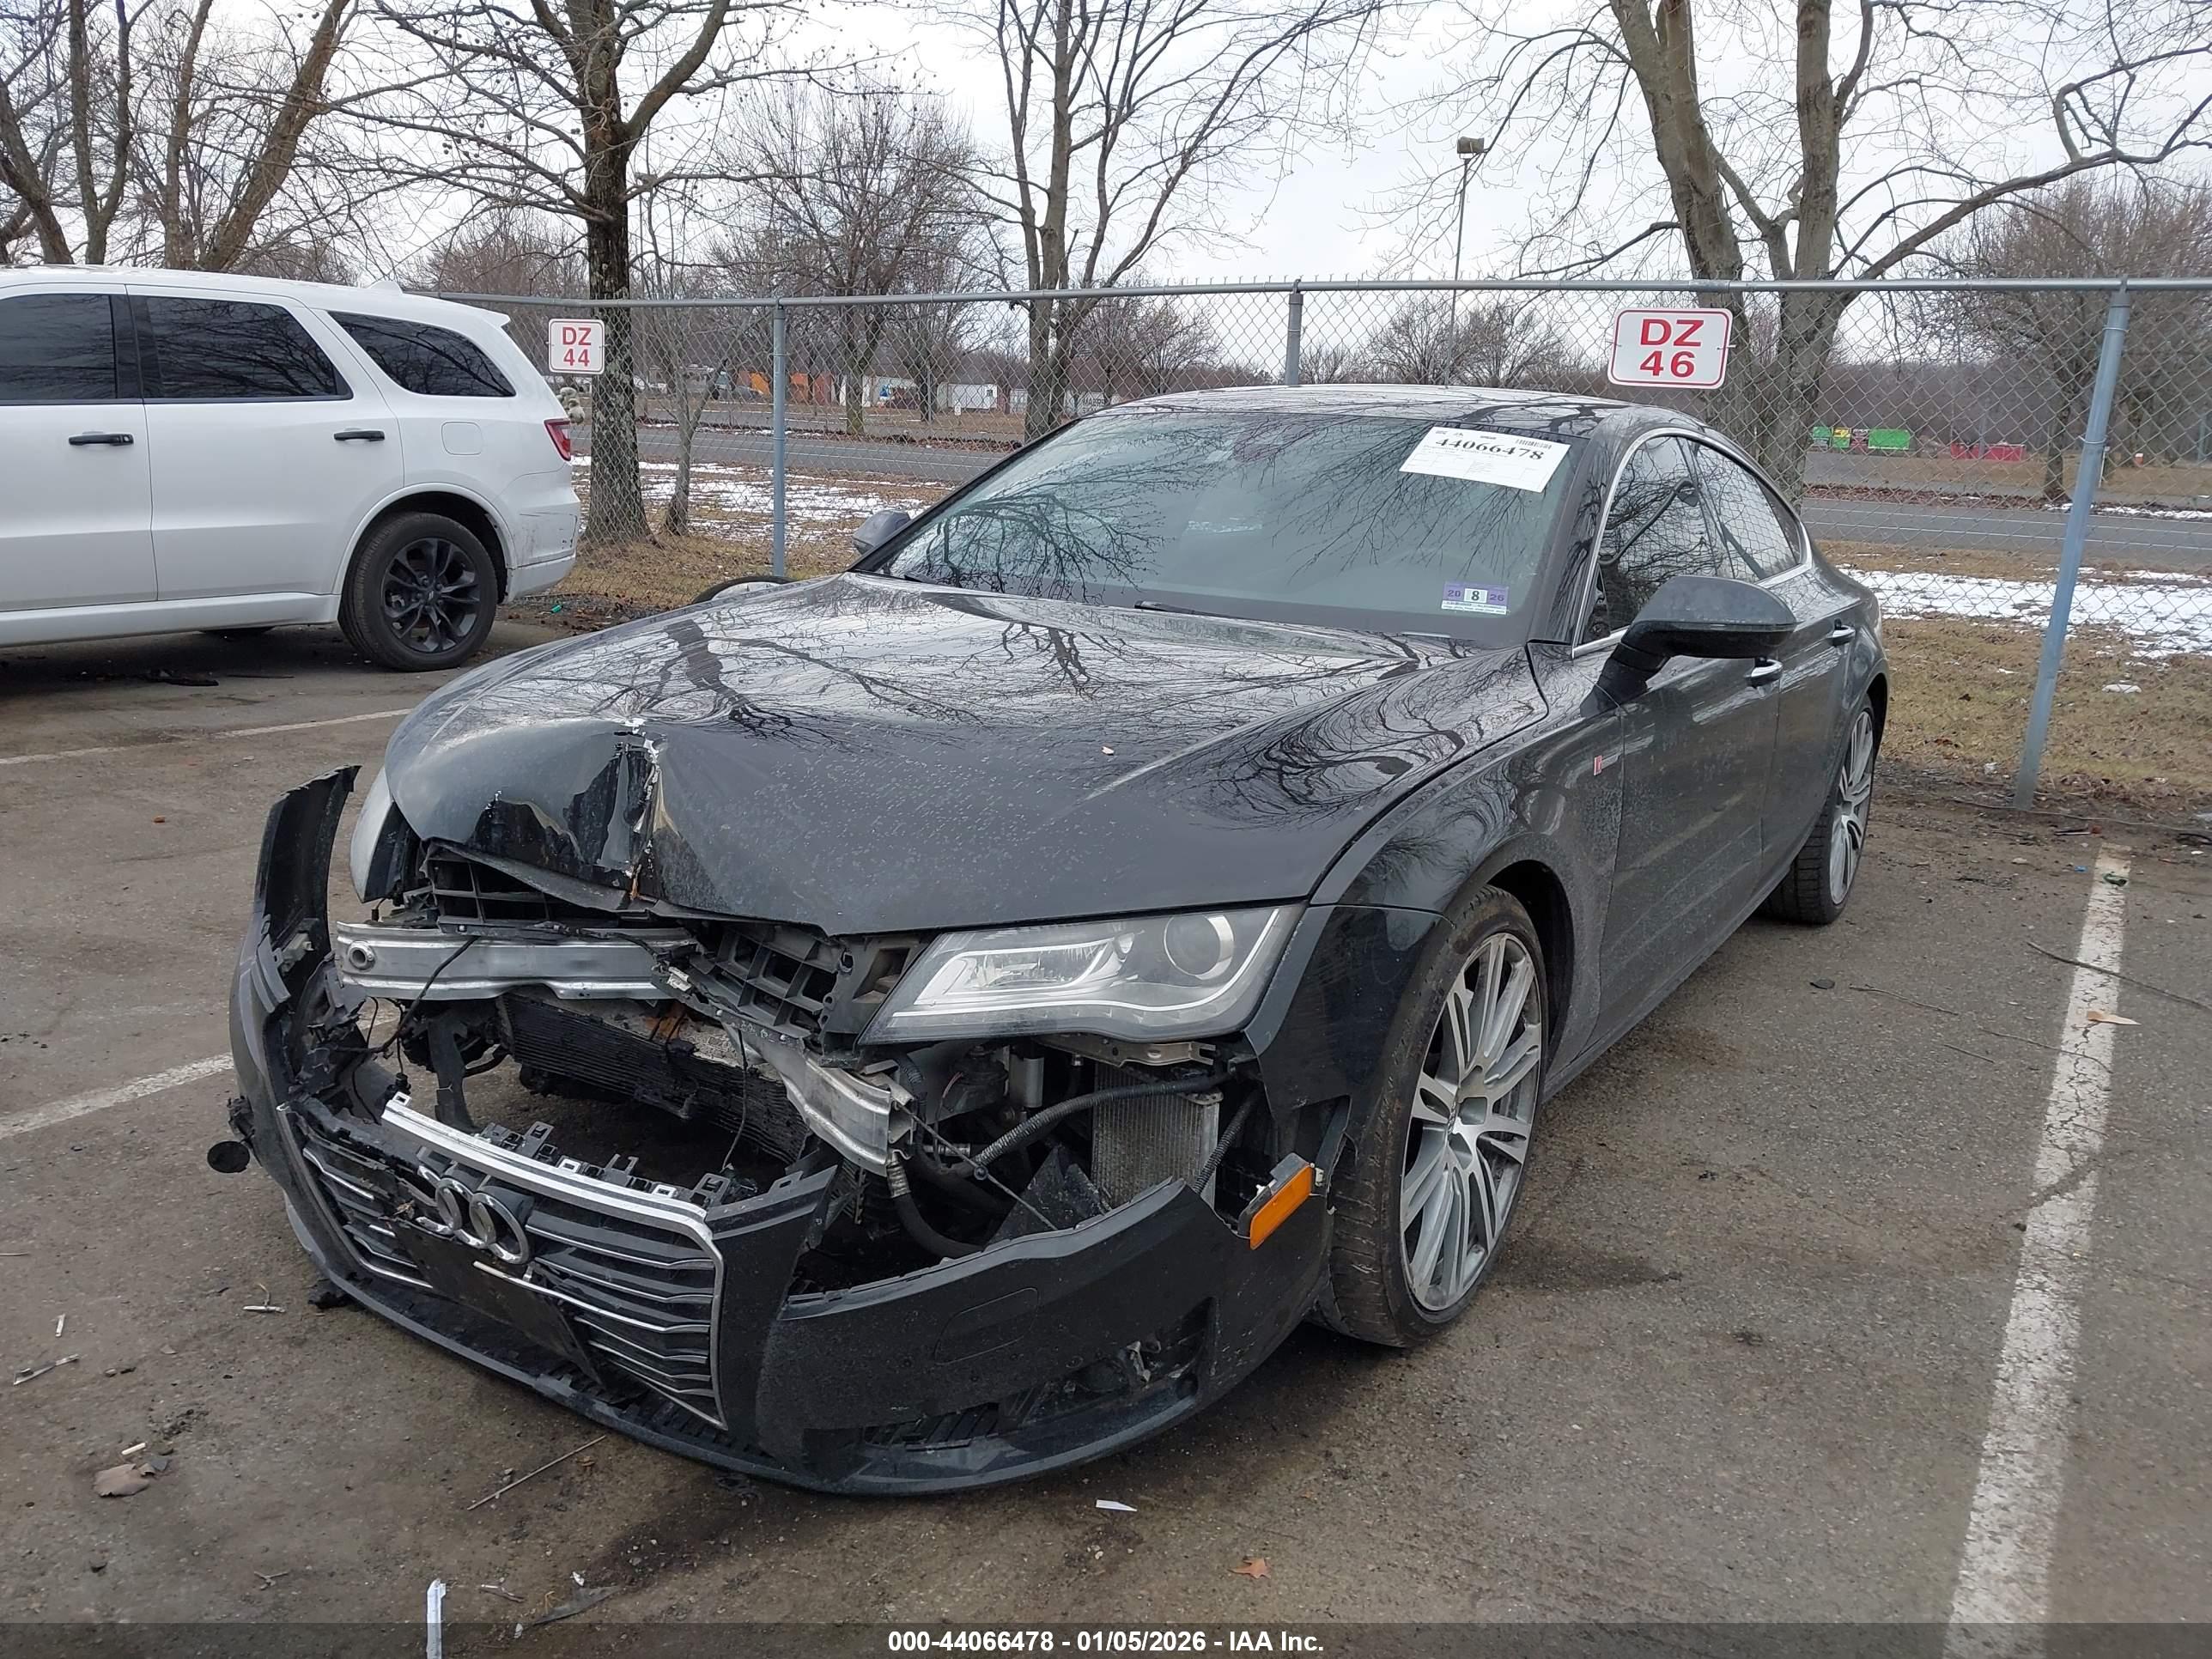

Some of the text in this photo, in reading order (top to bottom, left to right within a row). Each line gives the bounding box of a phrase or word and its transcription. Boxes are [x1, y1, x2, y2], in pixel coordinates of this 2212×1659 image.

[562, 327, 592, 346] DZ
[1640, 319, 1705, 347] DZ
[563, 349, 590, 367] 44
[1639, 350, 1695, 378] 46
[1435, 439, 1545, 460] 44066478
[1448, 589, 1504, 602] 20 8 26
